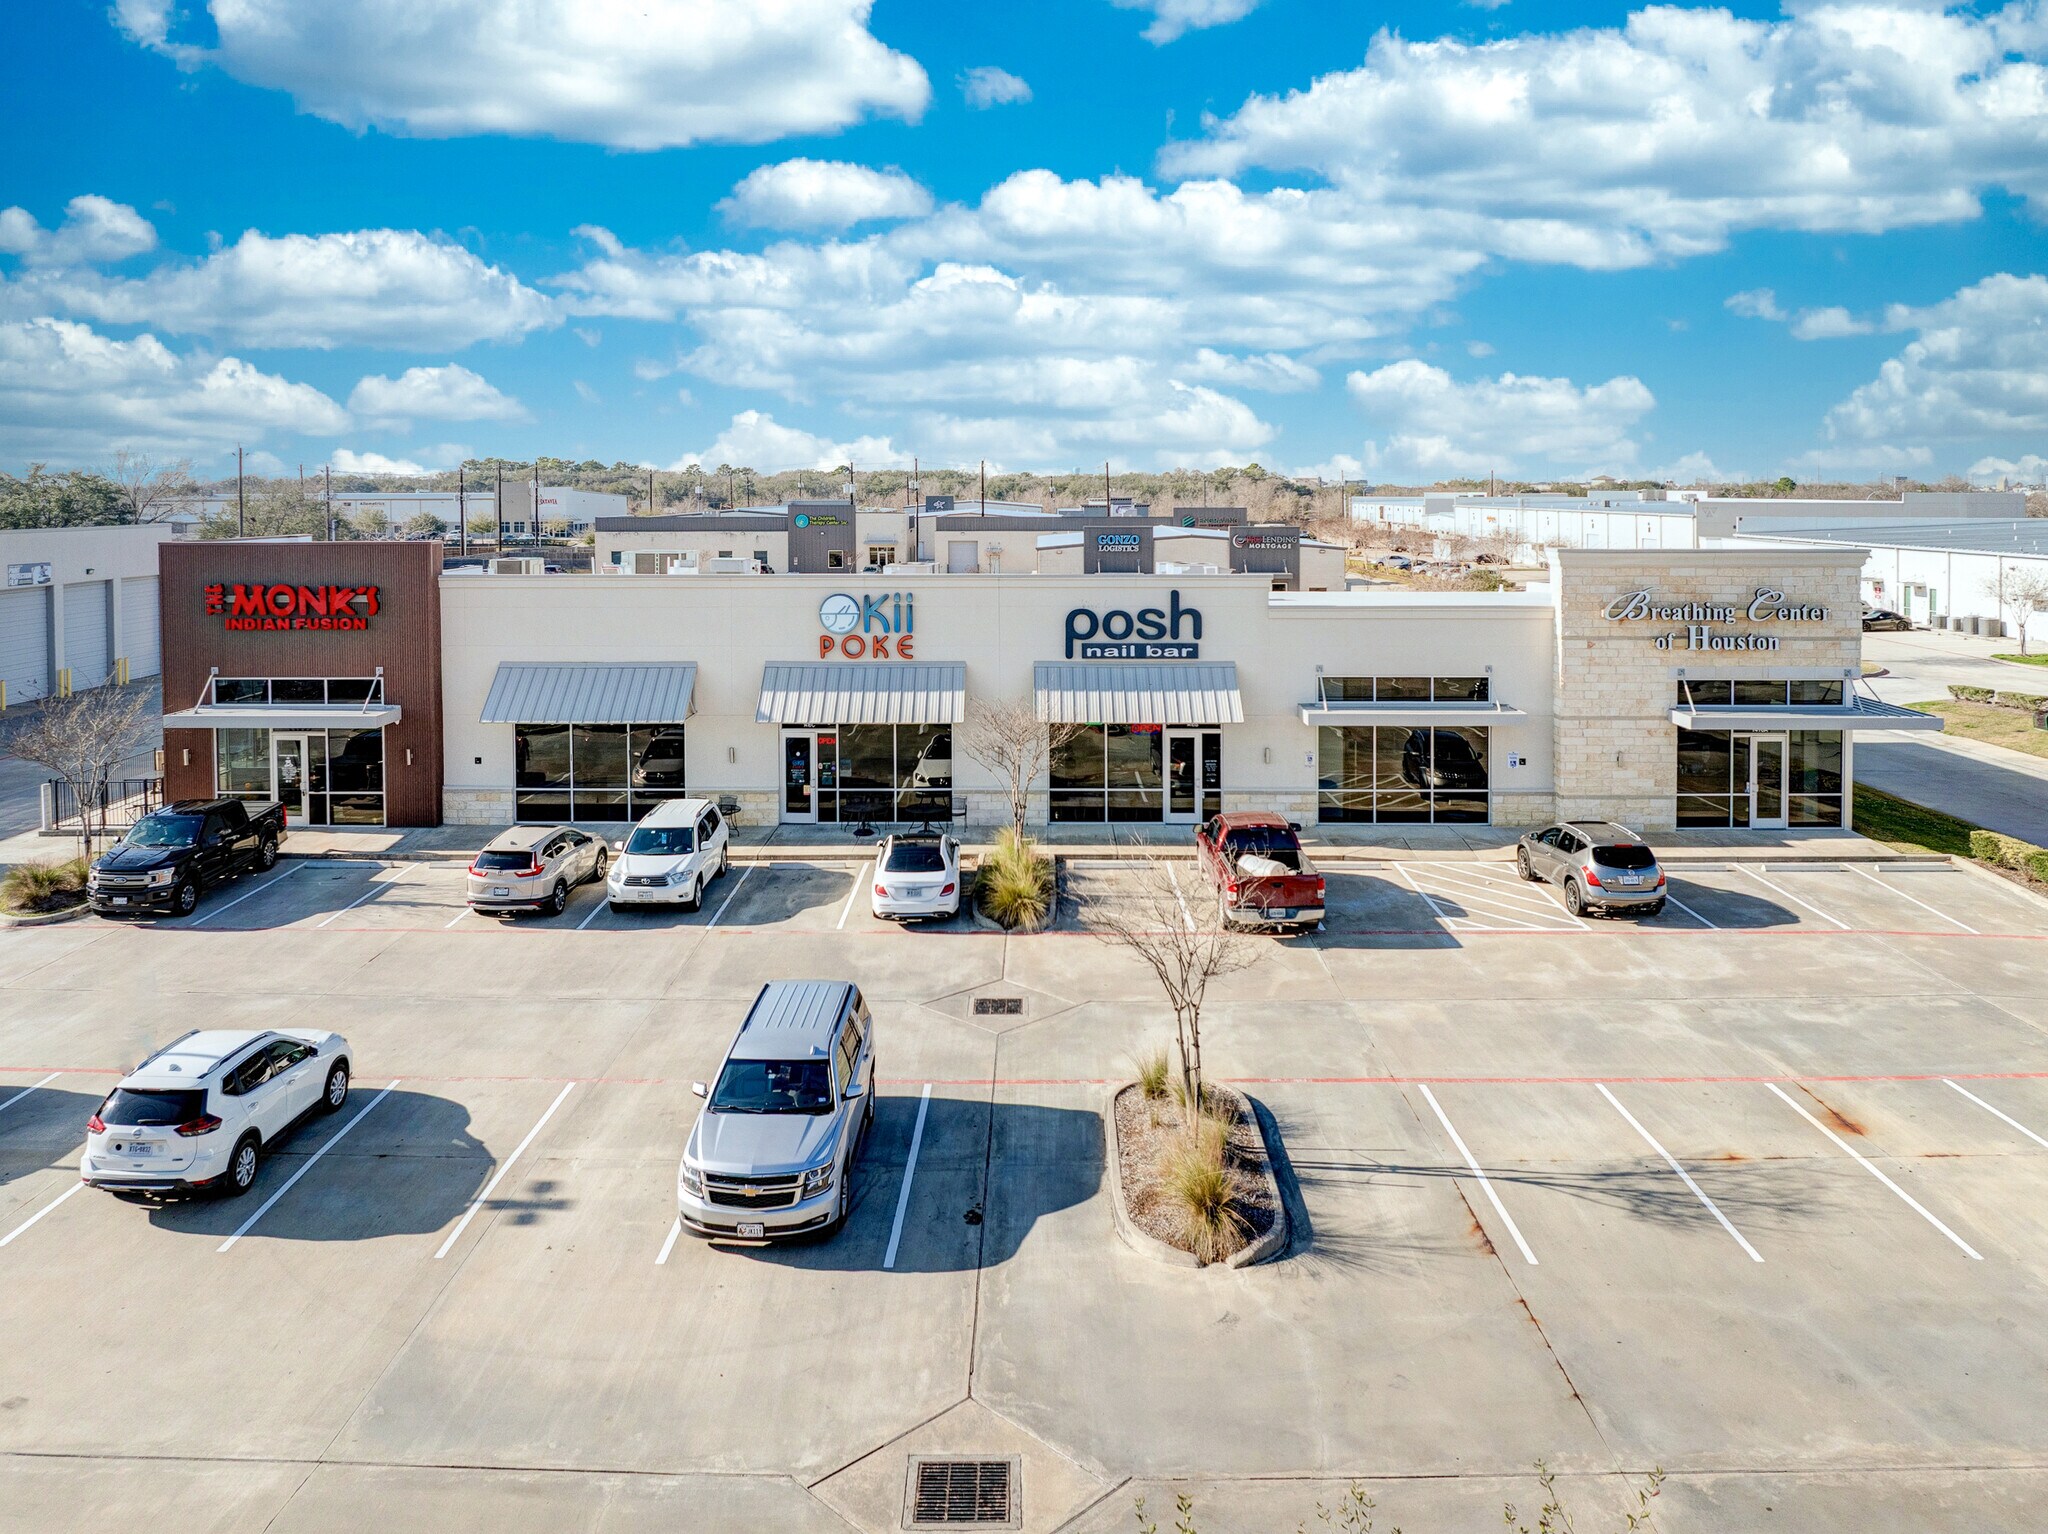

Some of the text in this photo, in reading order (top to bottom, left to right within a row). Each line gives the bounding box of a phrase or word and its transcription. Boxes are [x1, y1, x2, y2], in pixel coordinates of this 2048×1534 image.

[1097, 534, 1140, 545] GONZO
[1098, 544, 1140, 552] LOGISTICS
[204, 583, 225, 616] THE
[1604, 587, 1832, 625] Breathing Center
[224, 617, 368, 631] INDIAN FUSION
[1065, 589, 1203, 660] posh
[1654, 625, 1781, 652] of Houston
[819, 634, 914, 660] POKE
[1086, 645, 1194, 657] nail bar
[1131, 723, 1161, 733] OPEN
[818, 737, 836, 745] OPEN
